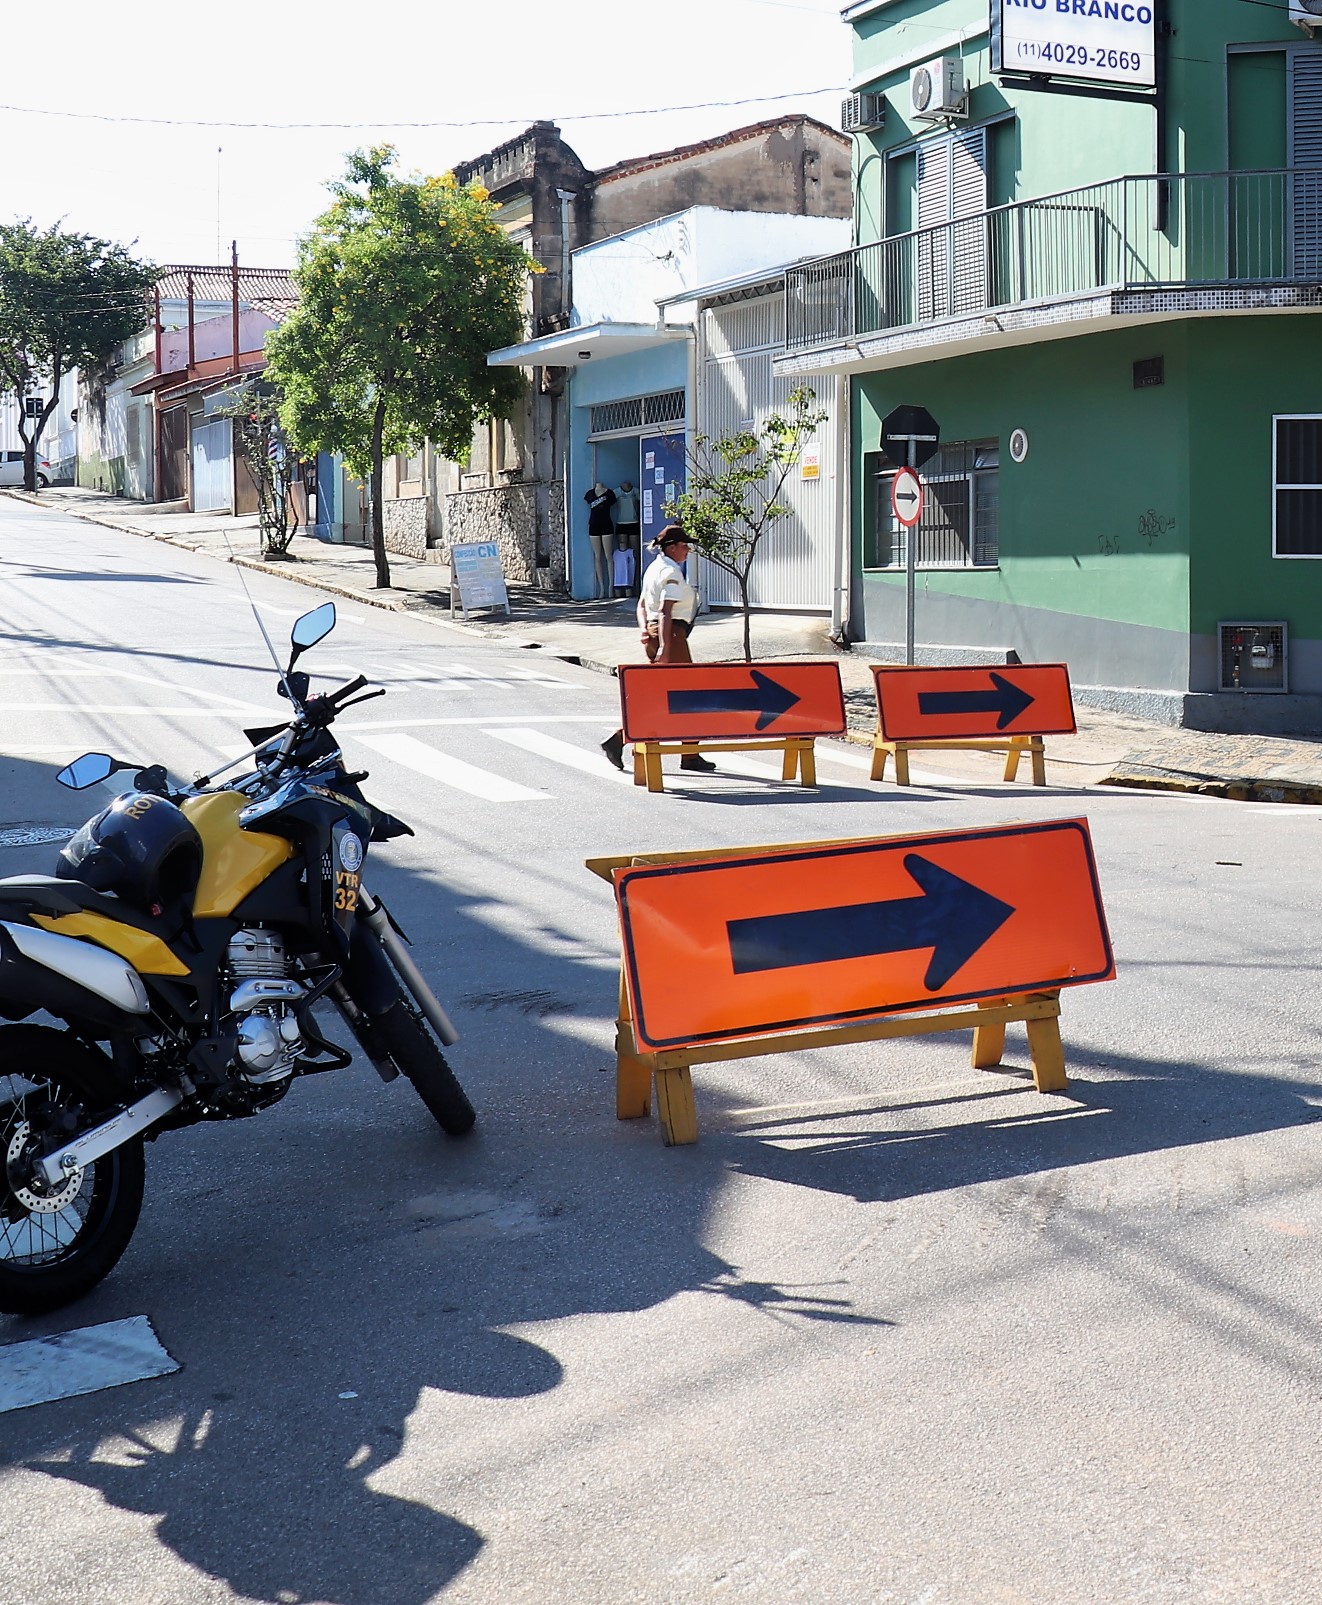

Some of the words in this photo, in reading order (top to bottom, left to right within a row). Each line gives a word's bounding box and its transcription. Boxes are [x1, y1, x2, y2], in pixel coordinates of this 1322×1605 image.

[1056, 0, 1152, 25] BRANCO
[1017, 42, 1141, 71] (11)4029-2669
[477, 544, 497, 558] CN
[335, 870, 359, 889] VTR
[335, 888, 357, 912] 32
